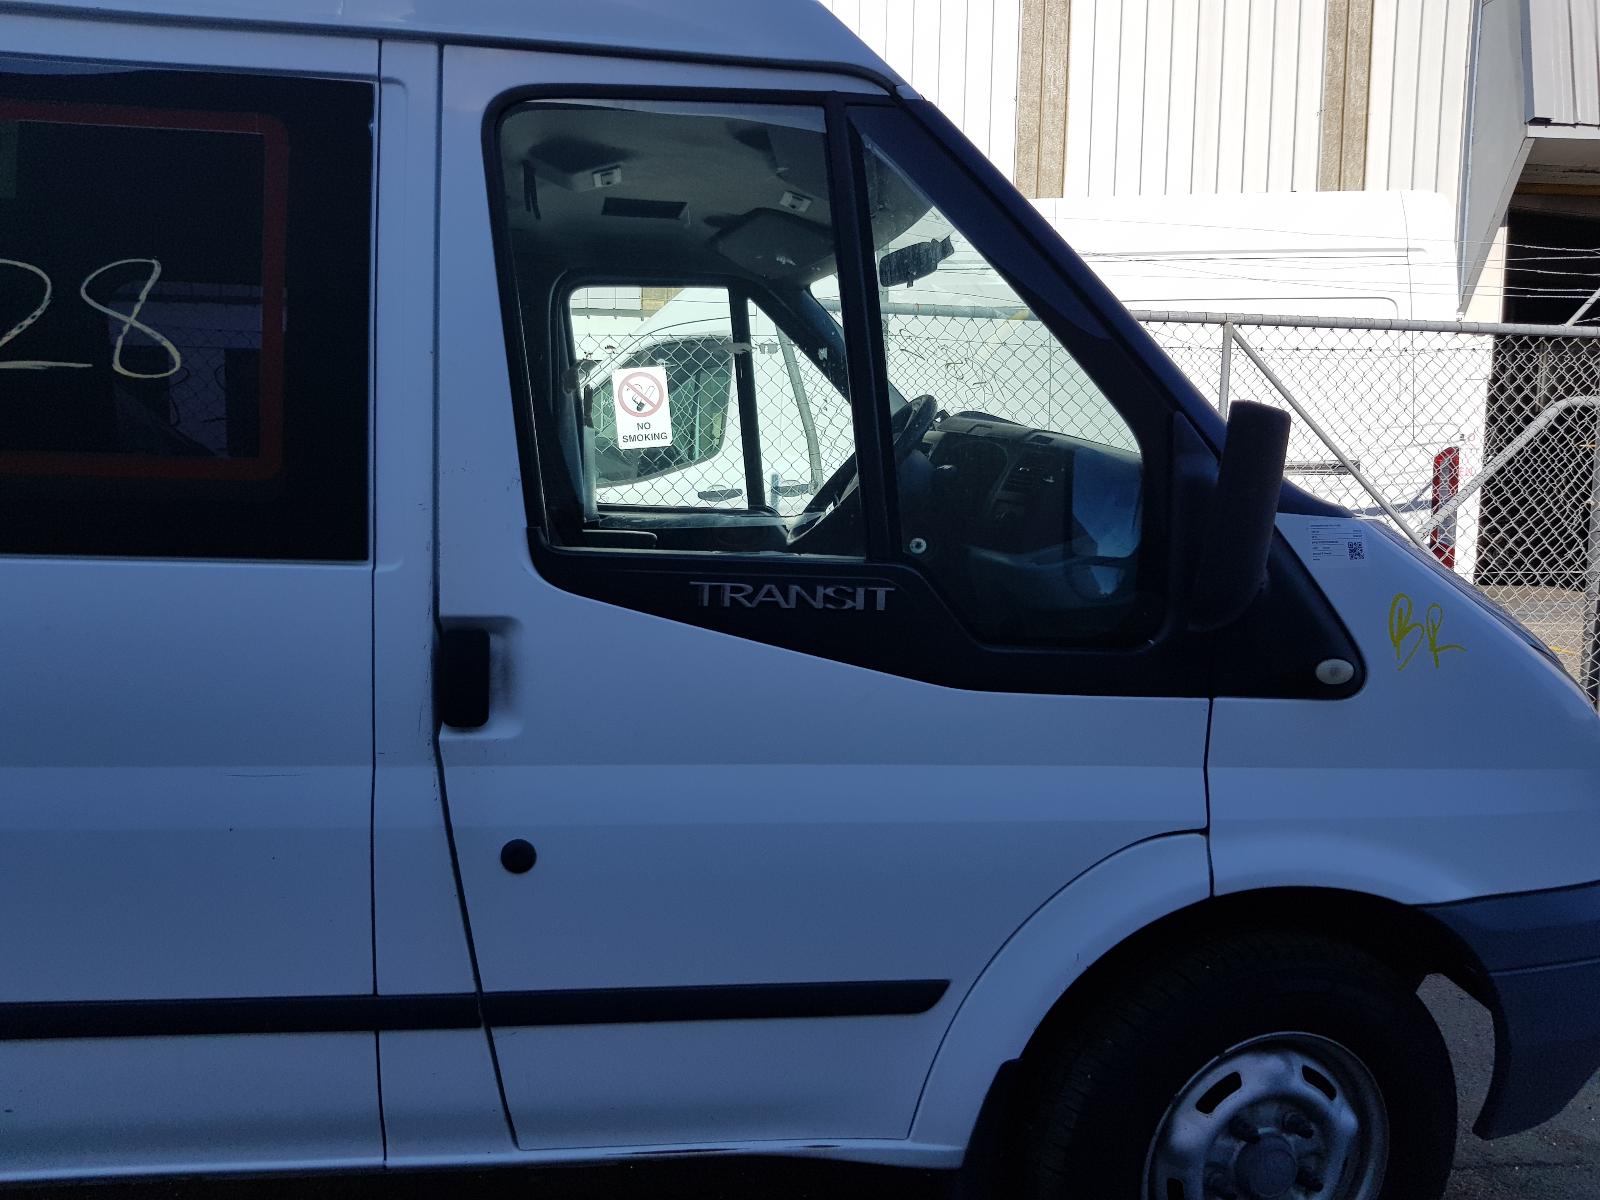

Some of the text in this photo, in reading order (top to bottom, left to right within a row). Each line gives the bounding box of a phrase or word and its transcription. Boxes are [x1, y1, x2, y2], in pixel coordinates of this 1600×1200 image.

[636, 421, 652, 431] NO
[622, 431, 668, 443] SMOKING
[689, 581, 896, 611] TRANSIT
